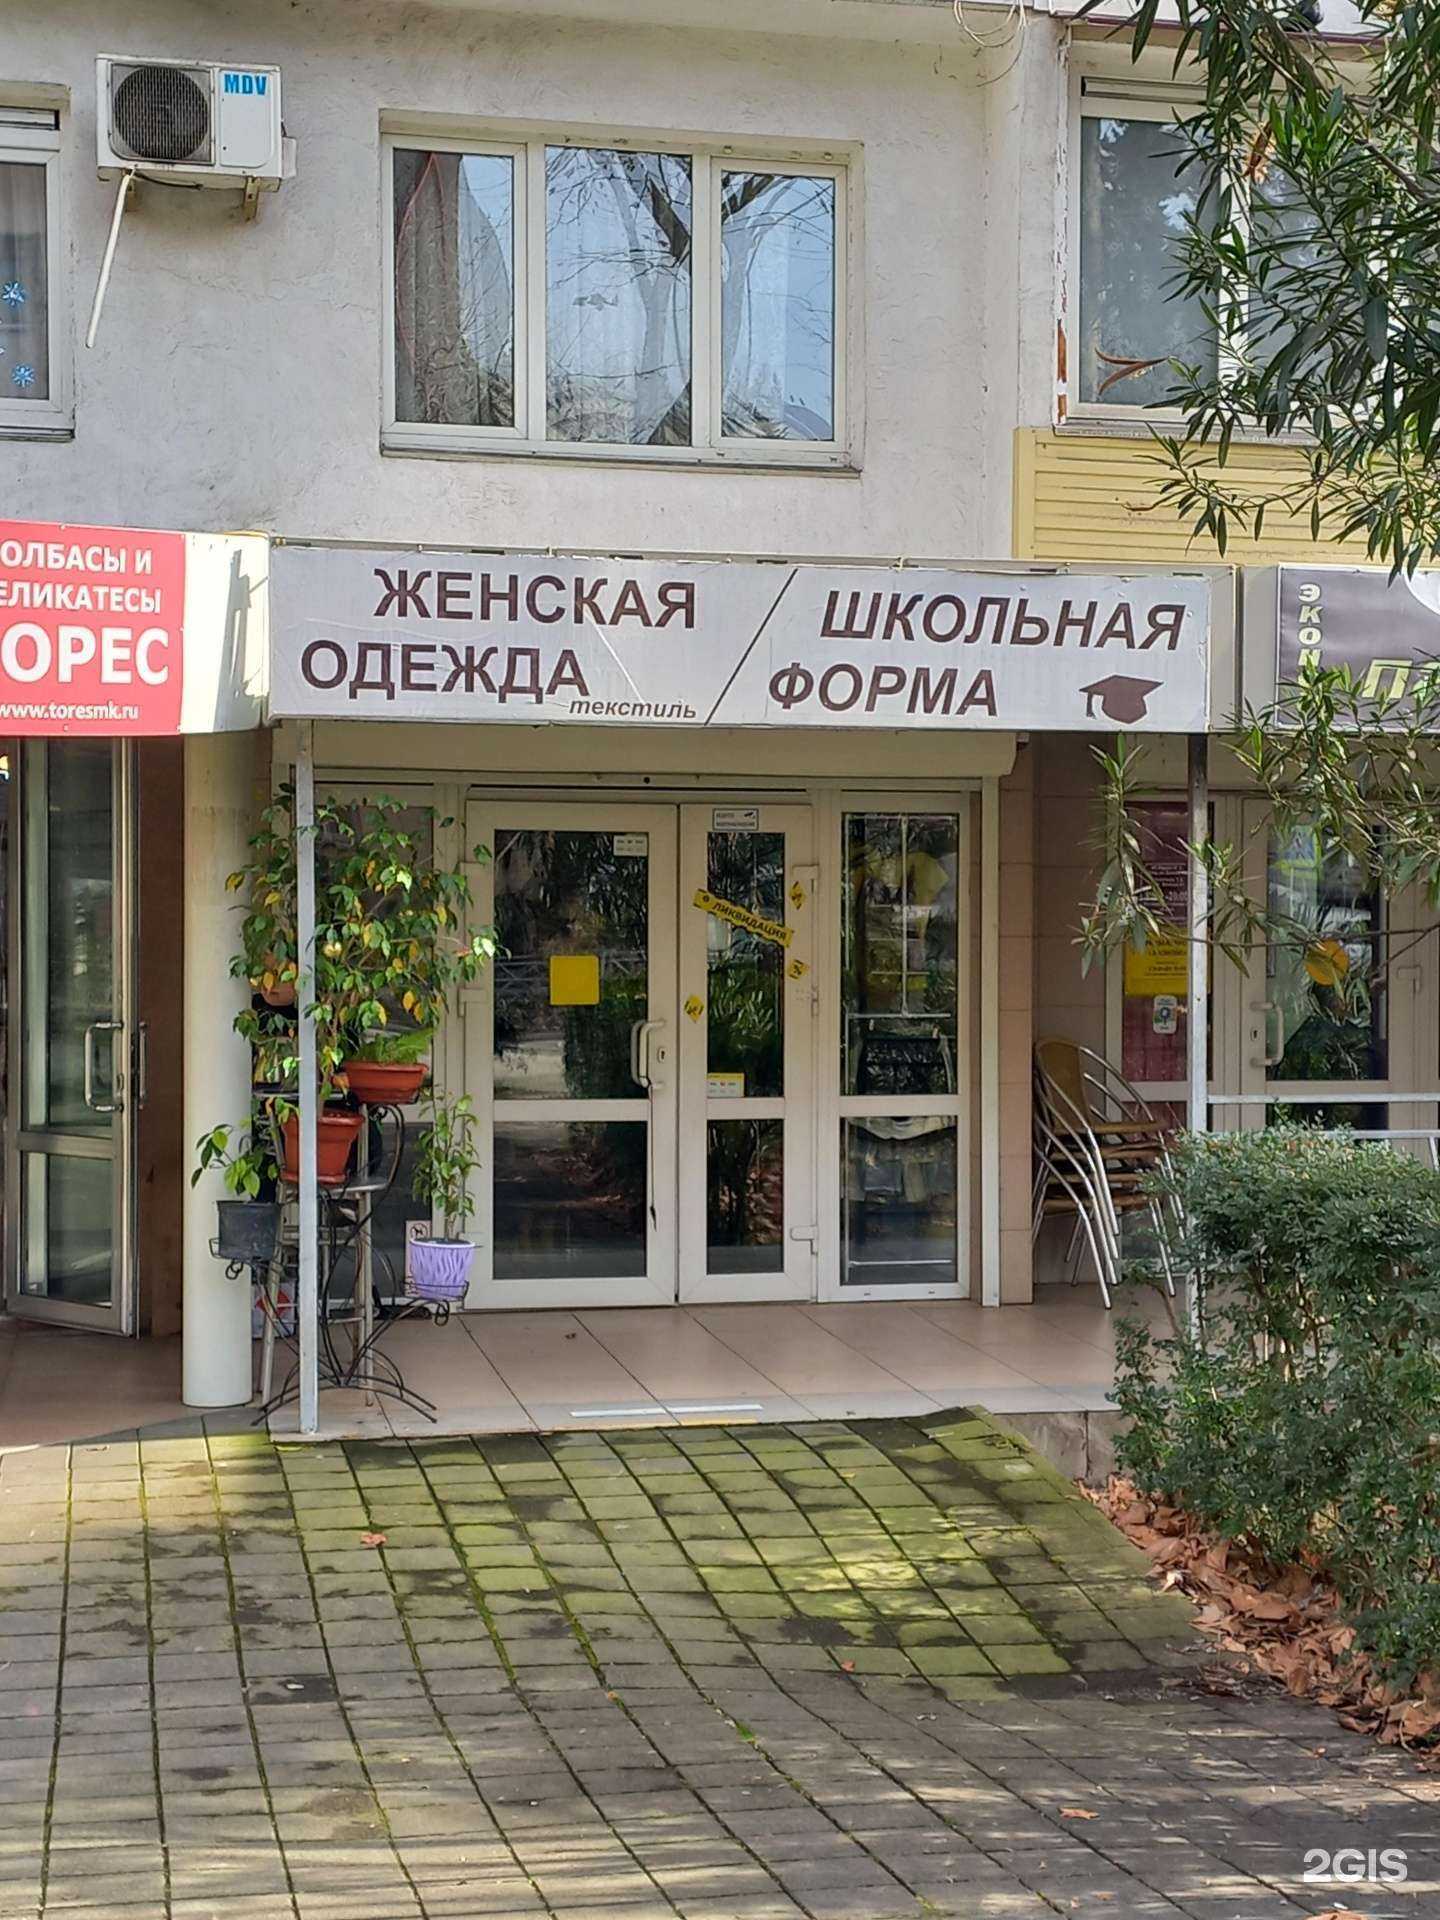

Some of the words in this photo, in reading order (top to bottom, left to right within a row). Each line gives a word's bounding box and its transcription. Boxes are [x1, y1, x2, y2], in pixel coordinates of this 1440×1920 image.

[224, 74, 267, 95] MDV
[0, 540, 126, 573] ОЛБАСЫ
[134, 549, 152, 574] И
[0, 580, 161, 613] ЕЛИКАТЕСЫ
[373, 568, 695, 629] ЖЕНСКАЯ
[820, 590, 1186, 650] ШКОЛЬНАЯ
[0, 621, 169, 685] ОРЕС
[301, 639, 590, 704] ОДЕЖДА
[569, 698, 697, 719] текстиль
[768, 662, 998, 717] ФОРМА
[0, 700, 139, 720] www.toresmk.ru
[711, 902, 787, 941] ЛИКВИДАЦИЯ
